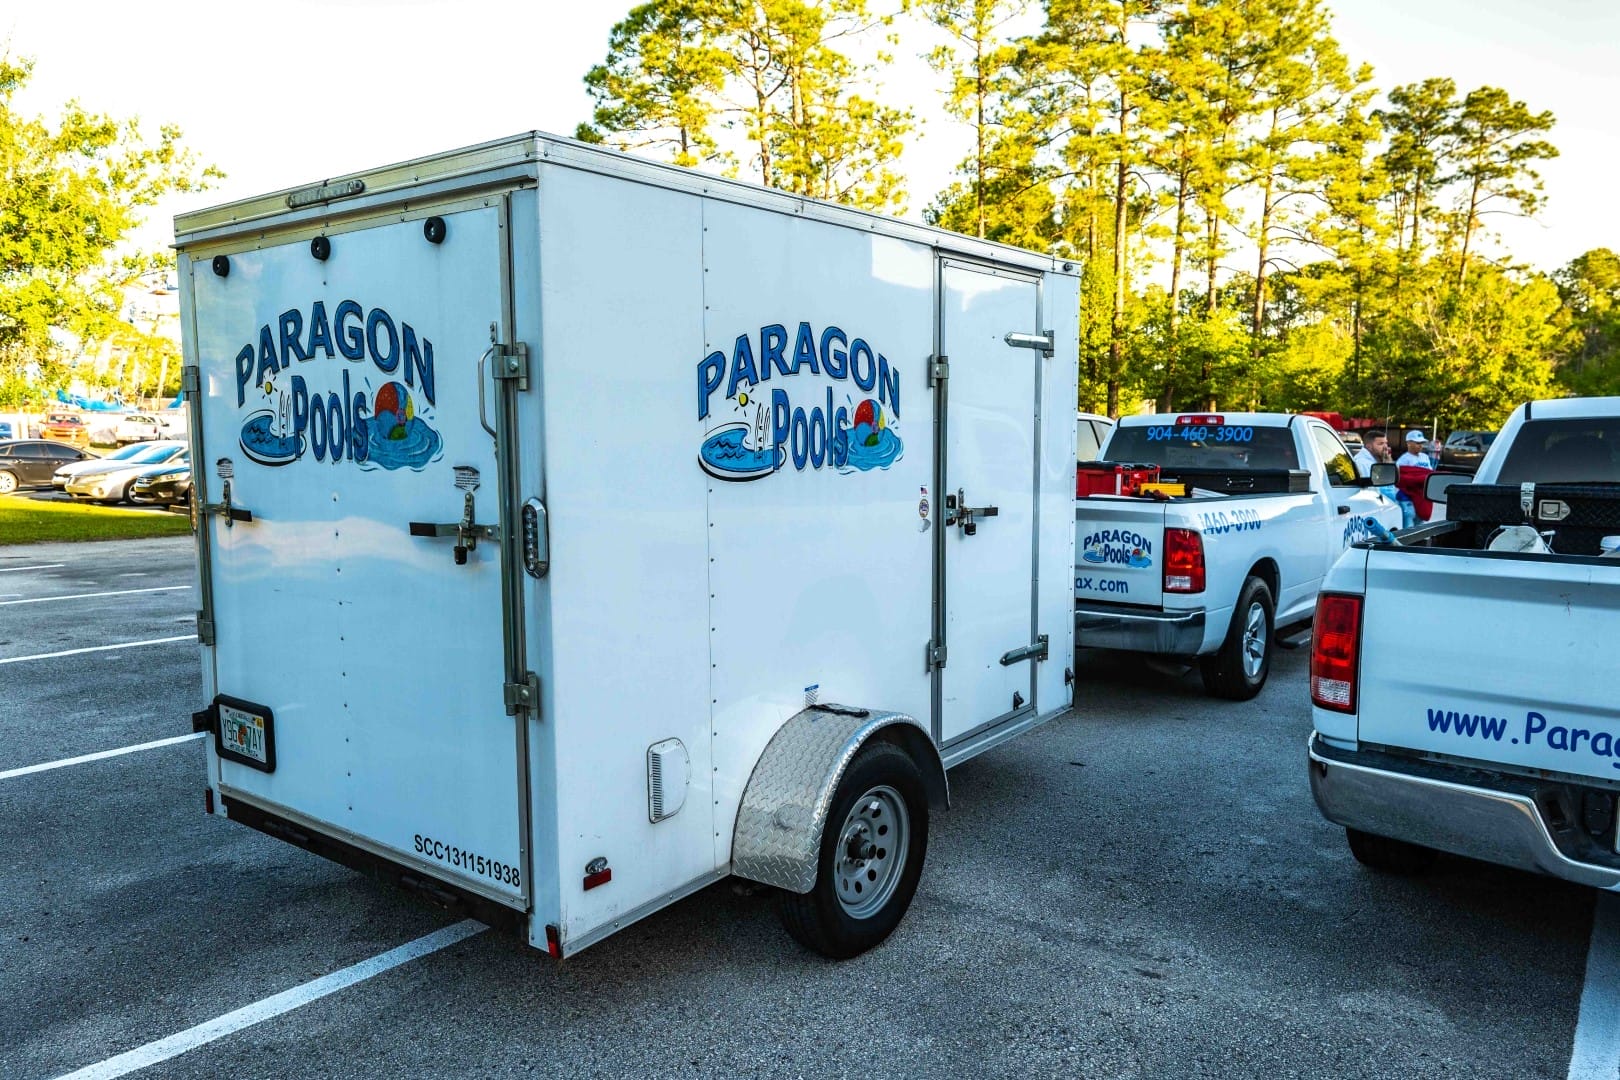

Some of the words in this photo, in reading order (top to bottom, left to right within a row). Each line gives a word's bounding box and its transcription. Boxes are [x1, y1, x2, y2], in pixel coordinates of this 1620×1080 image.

[236, 301, 434, 406] PARAGON
[698, 322, 900, 420] PARAGON
[291, 370, 369, 462] Pools
[772, 387, 848, 471] Pools
[1146, 427, 1253, 442] 904-460-3900
[1083, 529, 1152, 555] PARAGON
[1104, 544, 1130, 564] Pools
[414, 834, 521, 887] SCC131151938
